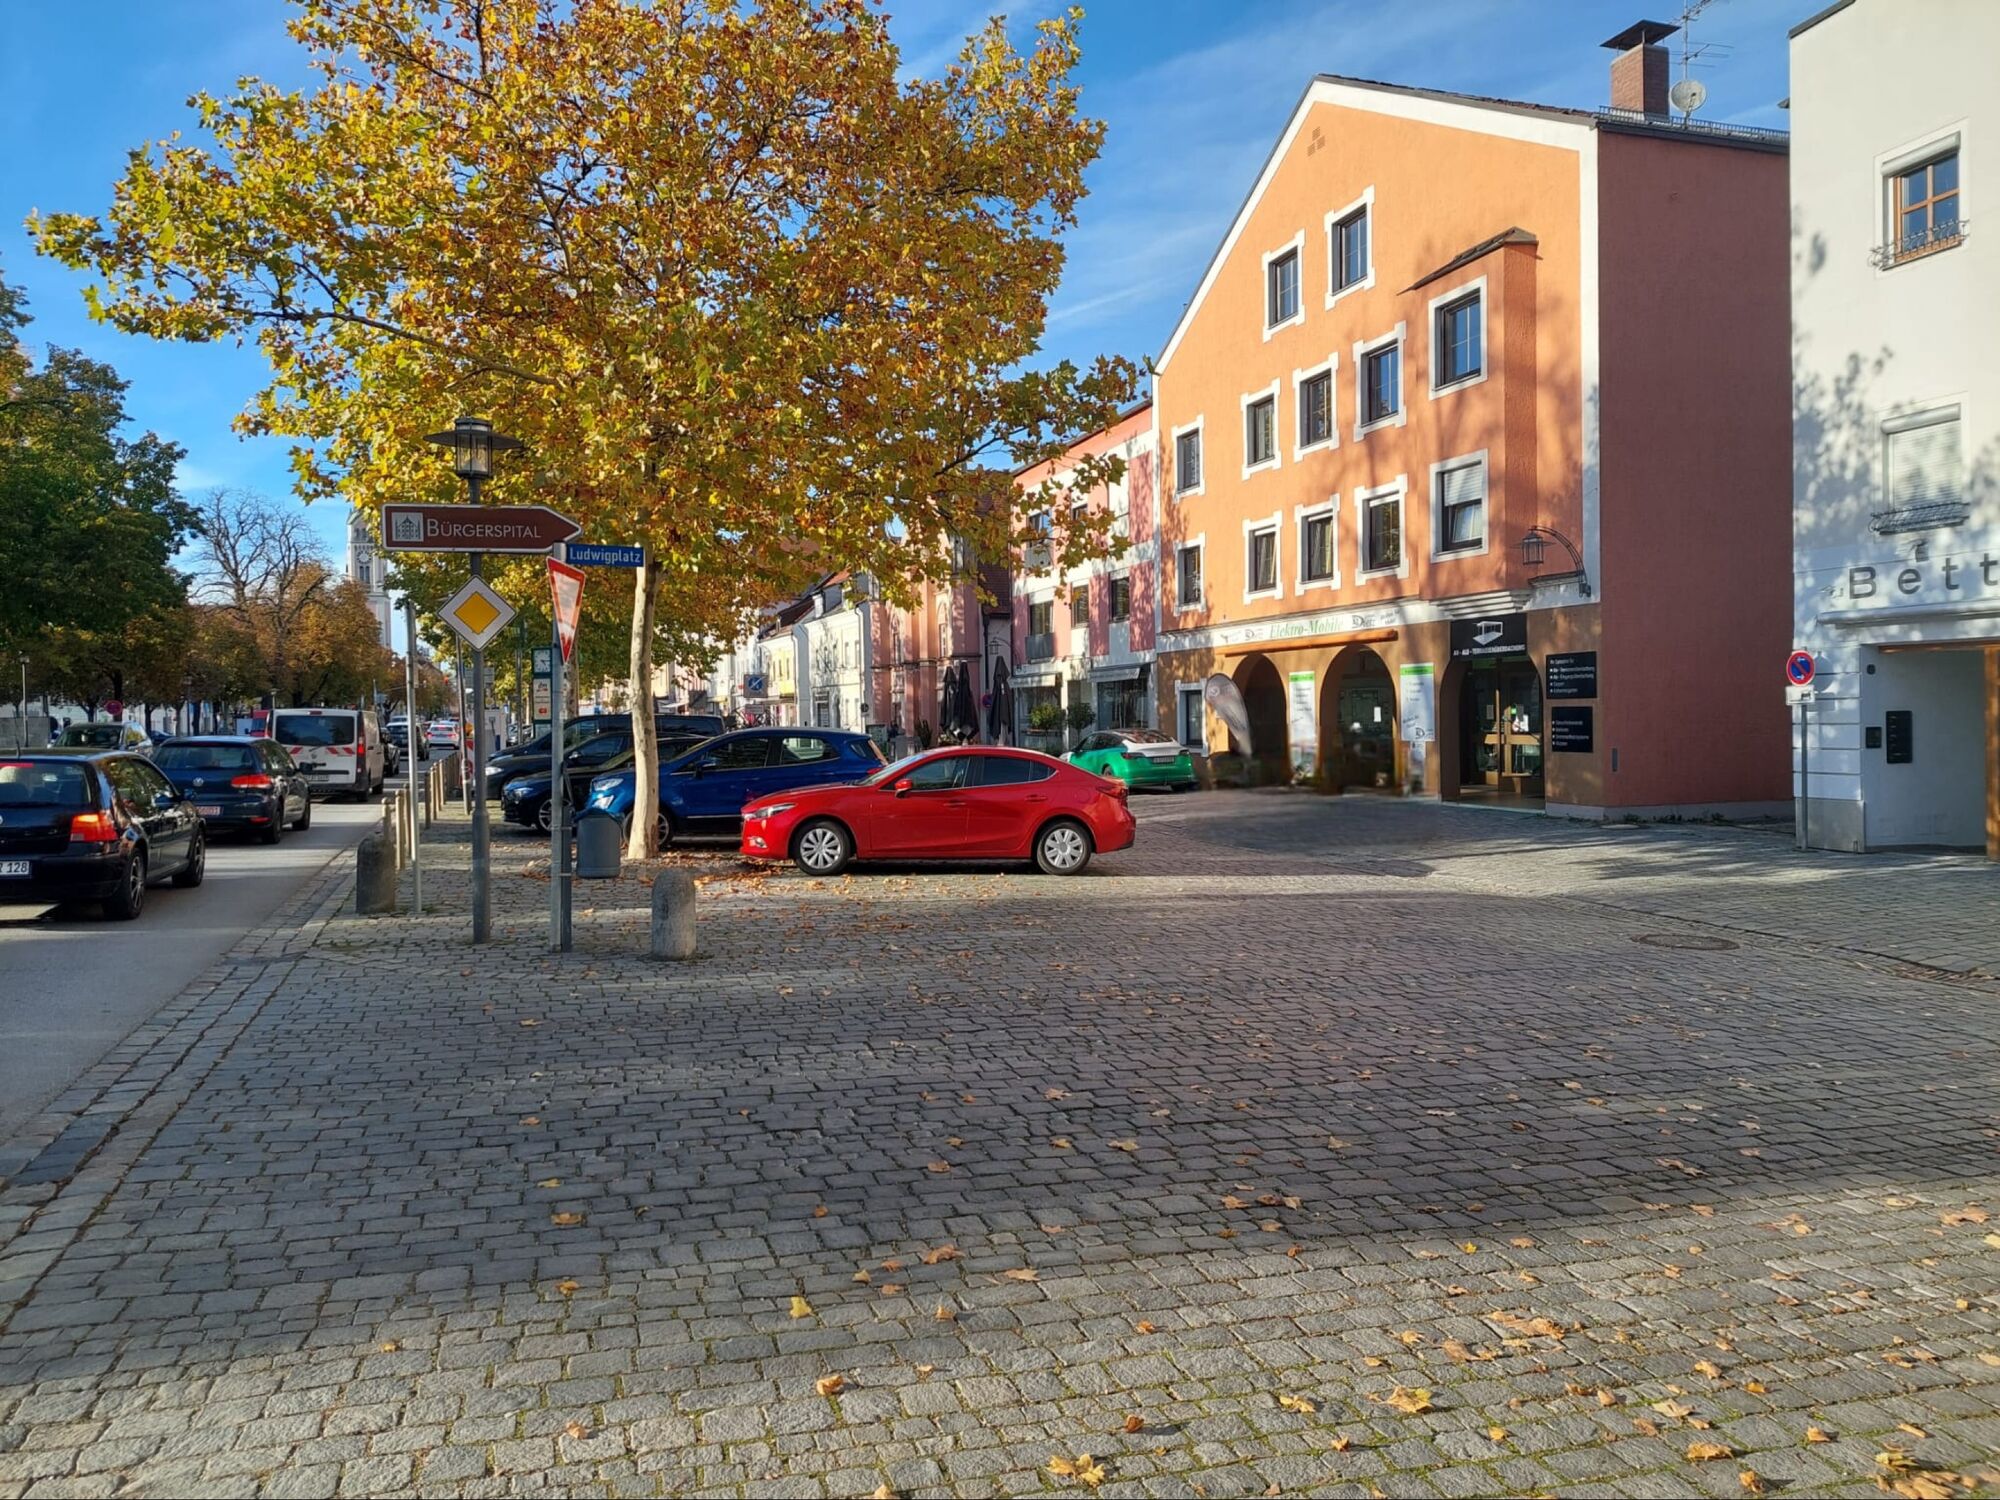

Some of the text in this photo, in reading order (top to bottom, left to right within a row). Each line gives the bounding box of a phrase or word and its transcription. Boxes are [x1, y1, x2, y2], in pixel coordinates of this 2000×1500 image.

[427, 518, 541, 539] BÜRGERSPITAL
[569, 547, 641, 565] Ludwigplatz
[6, 862, 28, 873] 128
